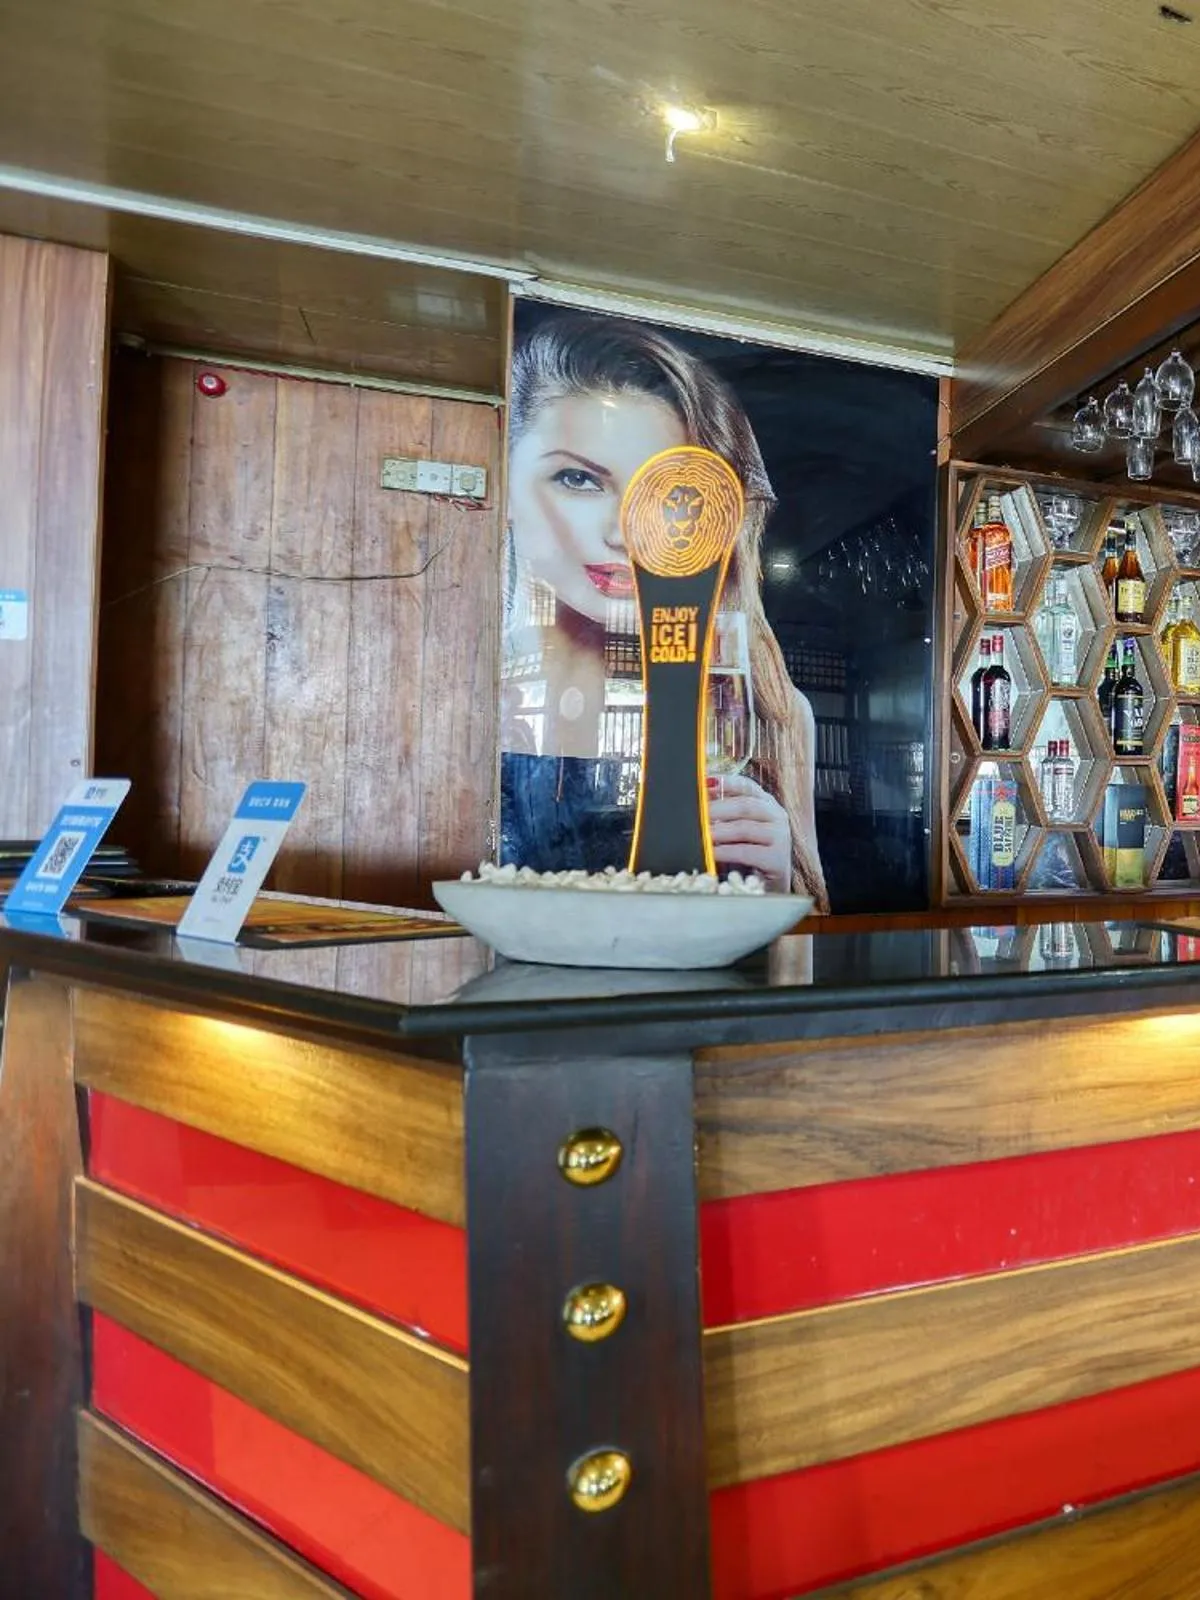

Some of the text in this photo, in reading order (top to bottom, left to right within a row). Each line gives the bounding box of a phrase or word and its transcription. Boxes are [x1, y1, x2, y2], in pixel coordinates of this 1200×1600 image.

[652, 607, 699, 623] ENJOY
[652, 624, 686, 645] ICE
[993, 816, 1004, 853] BLUE
